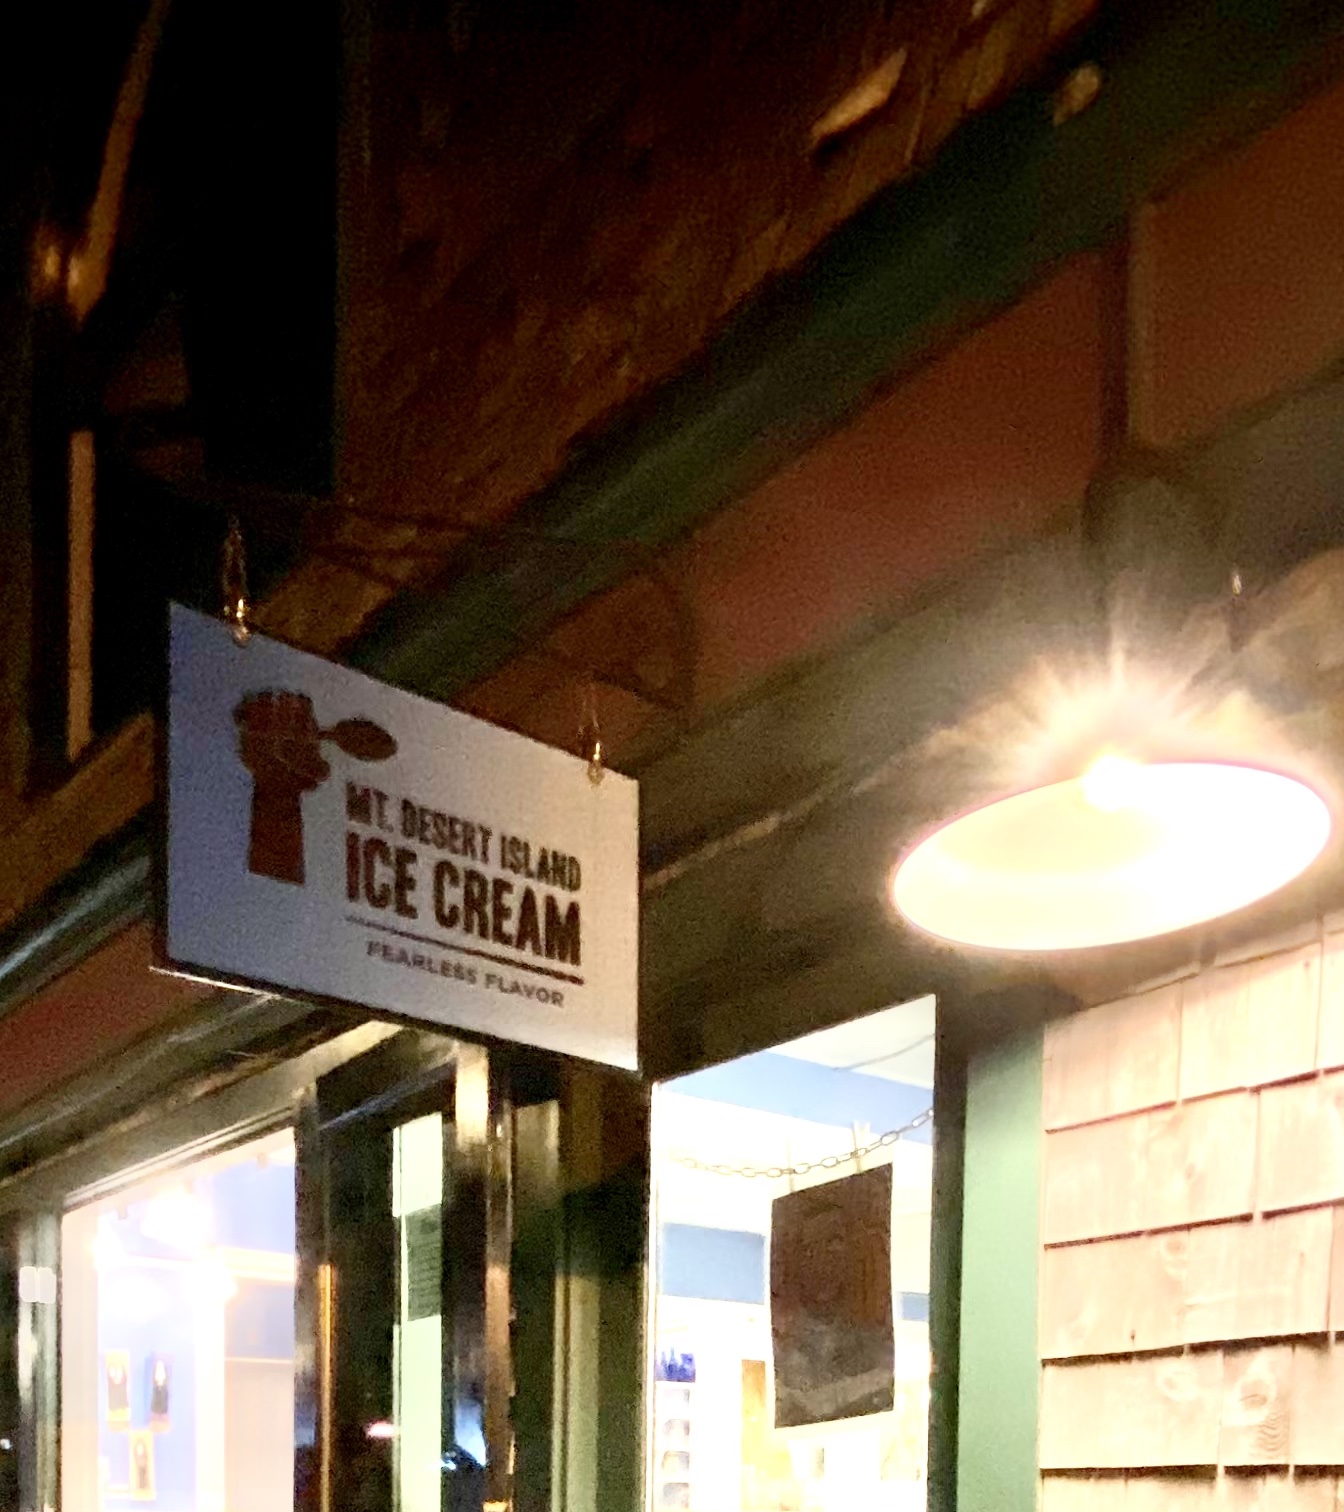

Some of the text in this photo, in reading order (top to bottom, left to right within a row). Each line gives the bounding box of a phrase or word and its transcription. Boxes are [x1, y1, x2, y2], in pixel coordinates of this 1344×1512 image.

[345, 781, 582, 893] MT. DESERT ISLAND
[345, 831, 582, 967] ICE CREAM
[366, 940, 566, 1008] FEARLESS FLAVOR
